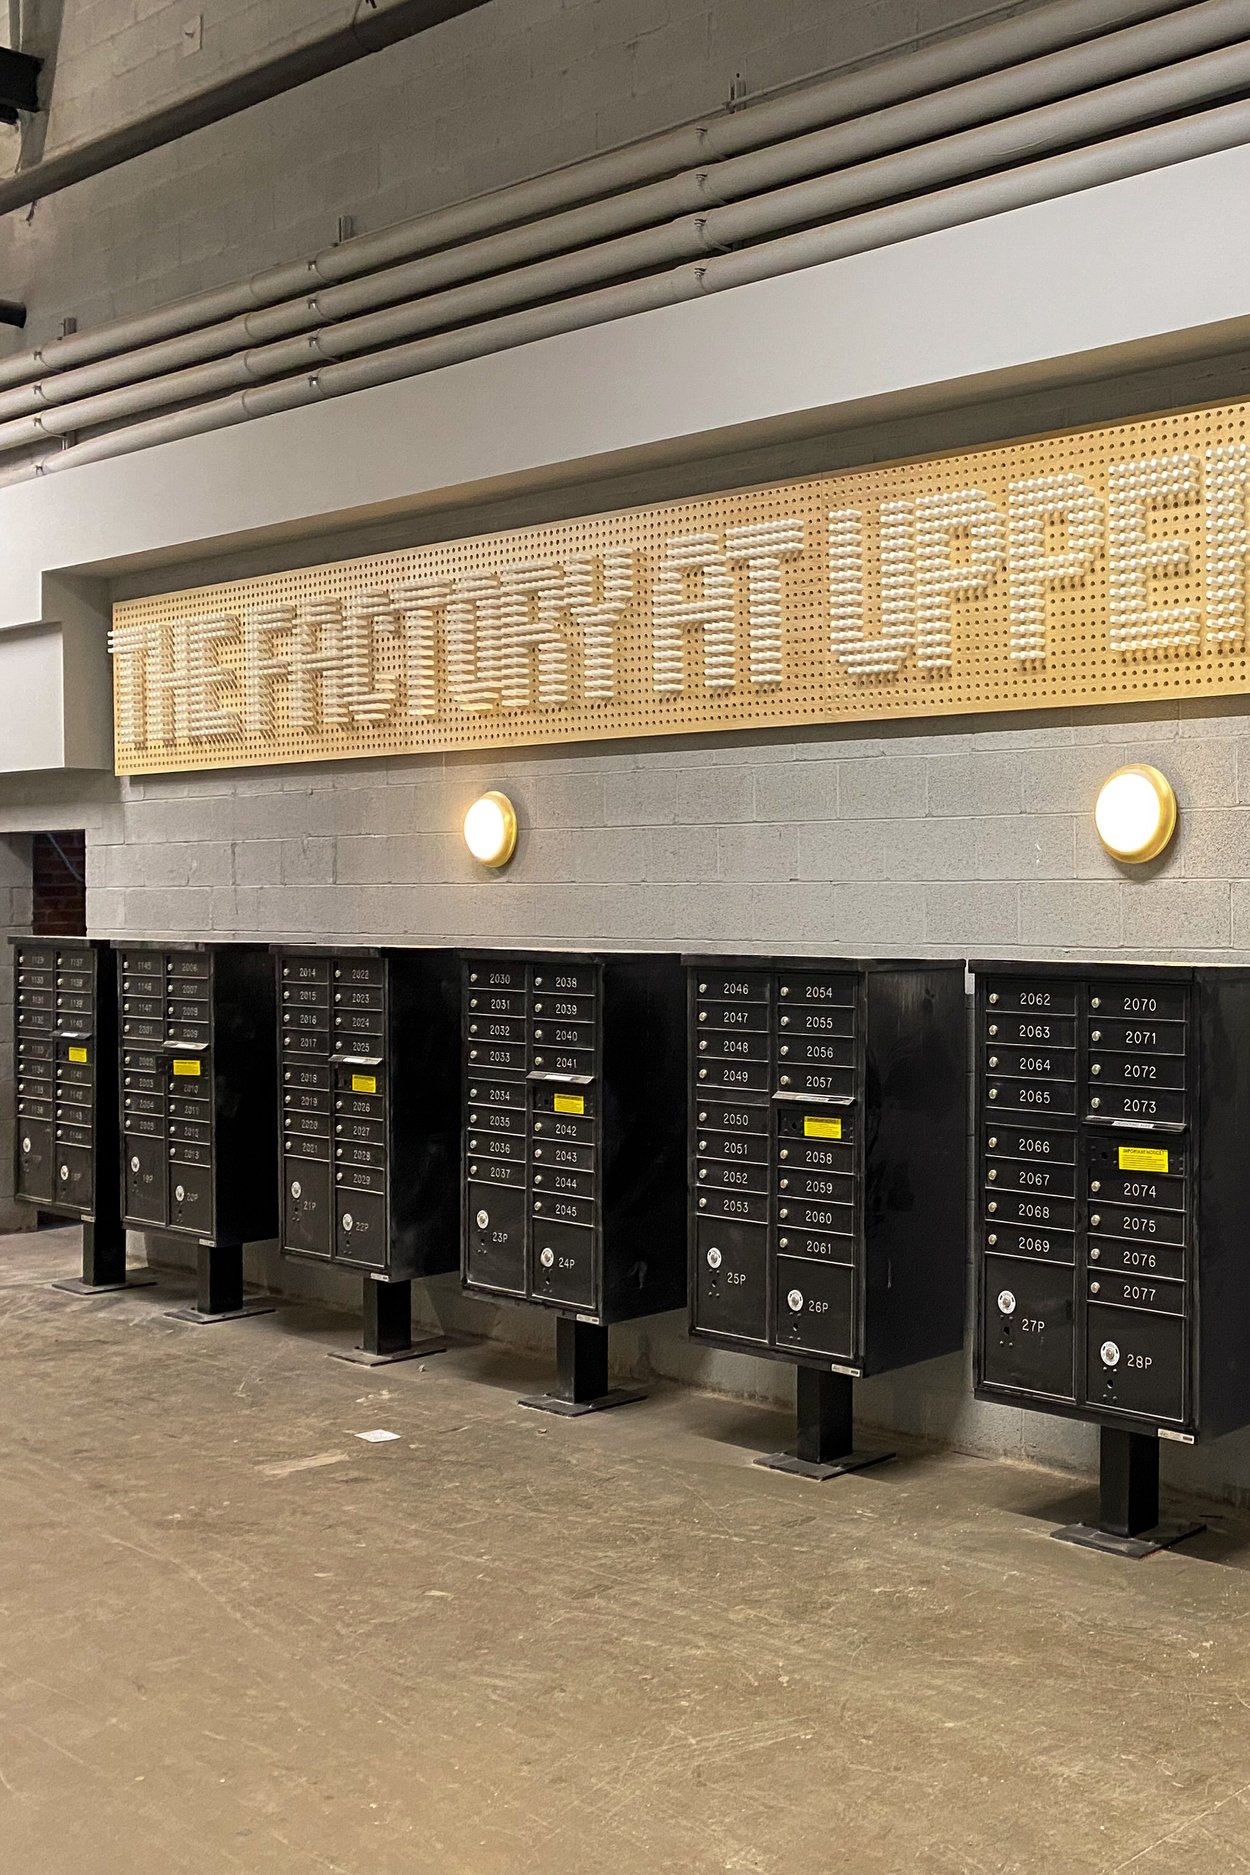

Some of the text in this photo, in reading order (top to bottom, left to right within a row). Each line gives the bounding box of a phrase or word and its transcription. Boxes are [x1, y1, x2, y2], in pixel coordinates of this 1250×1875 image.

[106, 612, 238, 743] THE
[245, 545, 636, 731] FACTORY
[652, 518, 805, 694] AT
[299, 967, 316, 977] 2014
[352, 969, 369, 980] 2022
[489, 973, 511, 985] 2030
[555, 977, 577, 988] 2038
[723, 982, 749, 995] 2046
[806, 986, 833, 999] 2054
[299, 991, 317, 1001] 2015
[352, 993, 370, 1004] 2023
[1020, 992, 1051, 1006] 2062
[490, 999, 510, 1010] 2031
[555, 1003, 577, 1015] 2039
[1124, 997, 1157, 1012] 2070
[352, 1017, 370, 1028] 2024
[723, 1011, 748, 1023] 2047
[806, 1016, 833, 1029] 2055
[490, 1024, 510, 1036] 2032
[555, 1029, 578, 1042] 2040
[1019, 1024, 1050, 1039] 2063
[300, 1037, 317, 1047] 2017
[1125, 1030, 1156, 1045] 2071
[353, 1041, 370, 1053] 2025
[723, 1040, 749, 1053] 2048
[806, 1045, 834, 1058] 2056
[490, 1051, 510, 1063] 2033
[556, 1057, 577, 1068] 2041
[1019, 1057, 1051, 1071] 2064
[723, 1069, 748, 1083] 2049
[1124, 1064, 1157, 1079] 2072
[806, 1075, 832, 1088] 2057
[489, 1089, 510, 1101] 2034
[1019, 1089, 1051, 1104] 2065
[1124, 1098, 1157, 1114] 2073
[490, 1115, 510, 1128] 2035
[723, 1112, 749, 1126] 2050
[353, 1125, 370, 1136] 2027
[555, 1123, 577, 1136] 2042
[302, 1142, 318, 1153] 2021
[490, 1141, 510, 1154] 2036
[724, 1141, 747, 1155] 2051
[1019, 1138, 1050, 1153] 2066
[555, 1150, 577, 1163] 2043
[806, 1150, 833, 1165] 2058
[490, 1166, 511, 1179] 2037
[723, 1170, 748, 1184] 2052
[1019, 1171, 1050, 1186] 2067
[555, 1176, 577, 1189] 2044
[806, 1180, 833, 1194] 2059
[1123, 1182, 1156, 1198] 2074
[303, 1200, 317, 1210] 21P
[555, 1203, 577, 1217] 2045
[723, 1199, 749, 1213] 2053
[1018, 1203, 1050, 1219] 2068
[805, 1210, 832, 1224] 2060
[1123, 1216, 1156, 1233] 2075
[492, 1231, 508, 1243] 23P
[806, 1240, 831, 1254] 2061
[1018, 1236, 1050, 1253] 2069
[558, 1257, 575, 1269] 24P
[1123, 1251, 1156, 1268] 2076
[727, 1272, 746, 1285] 25P
[1123, 1285, 1156, 1301] 2077
[808, 1300, 829, 1313] 26P
[1022, 1318, 1045, 1333] 27P
[1127, 1354, 1152, 1369] 28P
